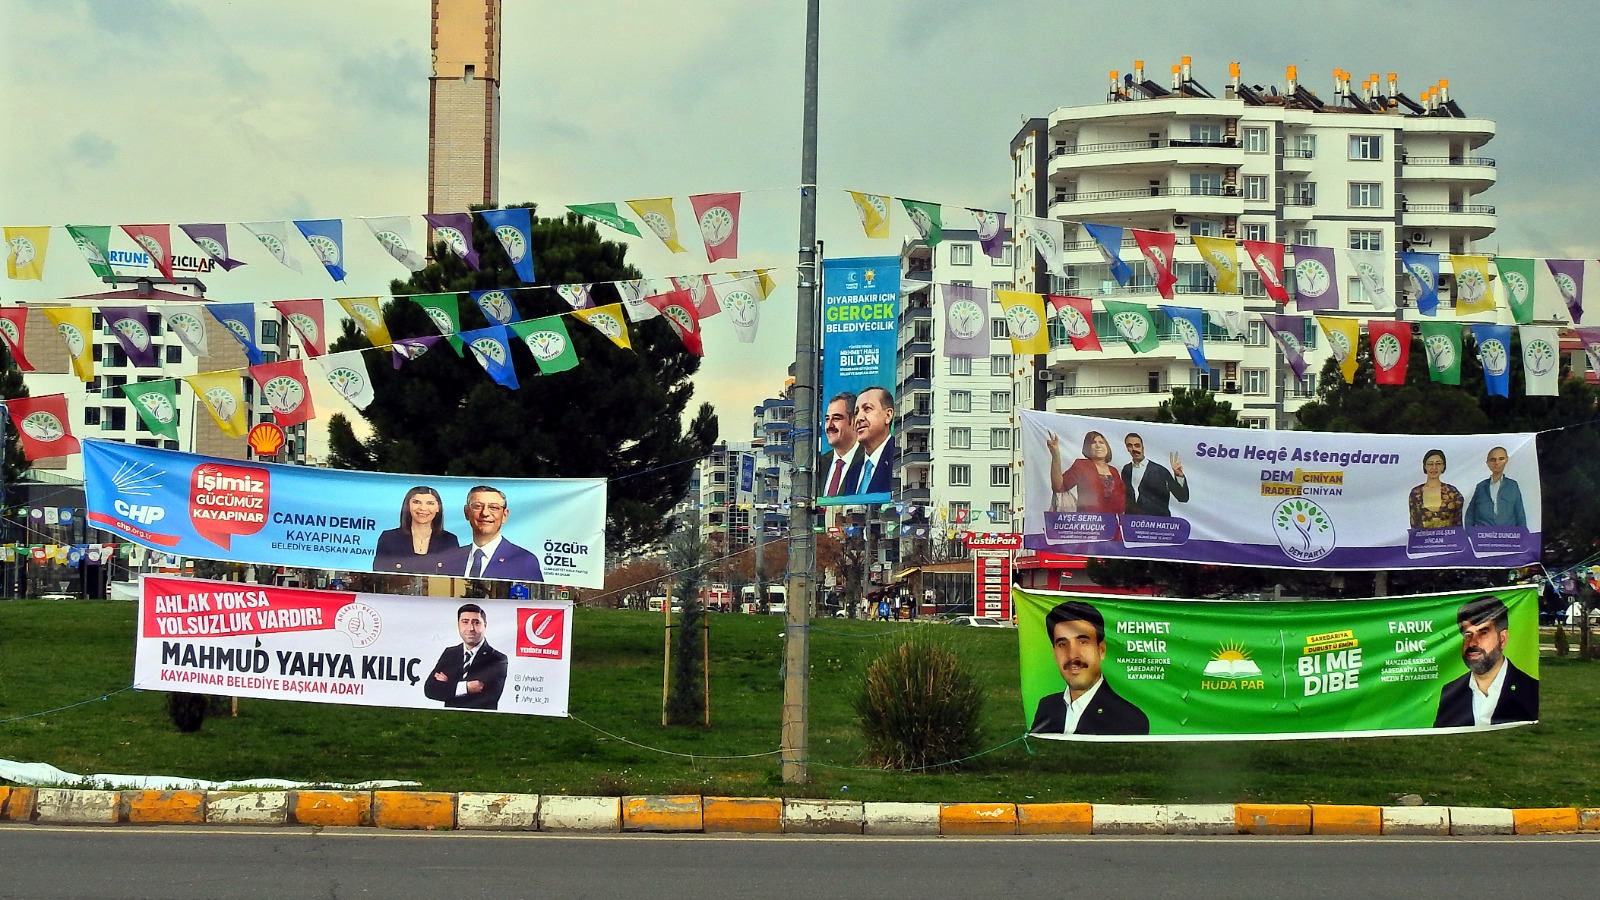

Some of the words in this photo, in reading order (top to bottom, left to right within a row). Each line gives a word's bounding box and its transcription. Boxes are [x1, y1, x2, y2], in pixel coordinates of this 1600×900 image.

[108, 250, 149, 264] RTUNE
[826, 303, 895, 322] GERÇEK
[1195, 442, 1240, 459] Seba
[1243, 446, 1288, 464] Heqê
[1290, 447, 1400, 467] Astengdaran
[1260, 469, 1294, 482] DEM
[196, 491, 264, 509] GÜCÜMÜZ
[114, 499, 165, 525] CHP
[193, 508, 264, 523] KAYAPINAR
[1057, 514, 1077, 522] AYŞE
[1077, 514, 1103, 522] SERRA
[273, 512, 327, 527] CANAN
[329, 516, 376, 531] DEMİR
[1053, 522, 1080, 530] BUCAK
[1156, 521, 1180, 530] HATUN
[116, 520, 152, 540] chp.org.tr
[286, 529, 361, 545] KAYAPINAR
[271, 541, 312, 552] BELEDİYE
[313, 544, 348, 554] BAŞKAN
[349, 547, 375, 556] ADAYI
[543, 539, 588, 555] ÖZGÜR
[1288, 545, 1303, 558] DEM
[543, 552, 577, 568] ÖZEL
[155, 592, 210, 614] AHLAK
[213, 590, 270, 610] YOKSA
[156, 610, 254, 636] YOLSUZLUK
[257, 606, 323, 630] VARDIR!
[1116, 621, 1171, 634] MEHMET
[1388, 620, 1433, 634] FARUK
[1126, 637, 1167, 653] DEMİR
[1395, 637, 1427, 654] DİNÇ
[161, 640, 270, 674] MAHMUD
[276, 650, 355, 679] YAHYA
[361, 654, 422, 687] KILIÇ
[1298, 654, 1321, 676] BI
[1326, 648, 1363, 672] ME
[160, 668, 224, 686] KAYAPINAR
[227, 675, 280, 691] BELEDİYE
[282, 680, 328, 695] BAŞKAN
[330, 683, 365, 695] ADAYI
[1241, 680, 1265, 690] PAR
[1304, 668, 1360, 697] DIBE
